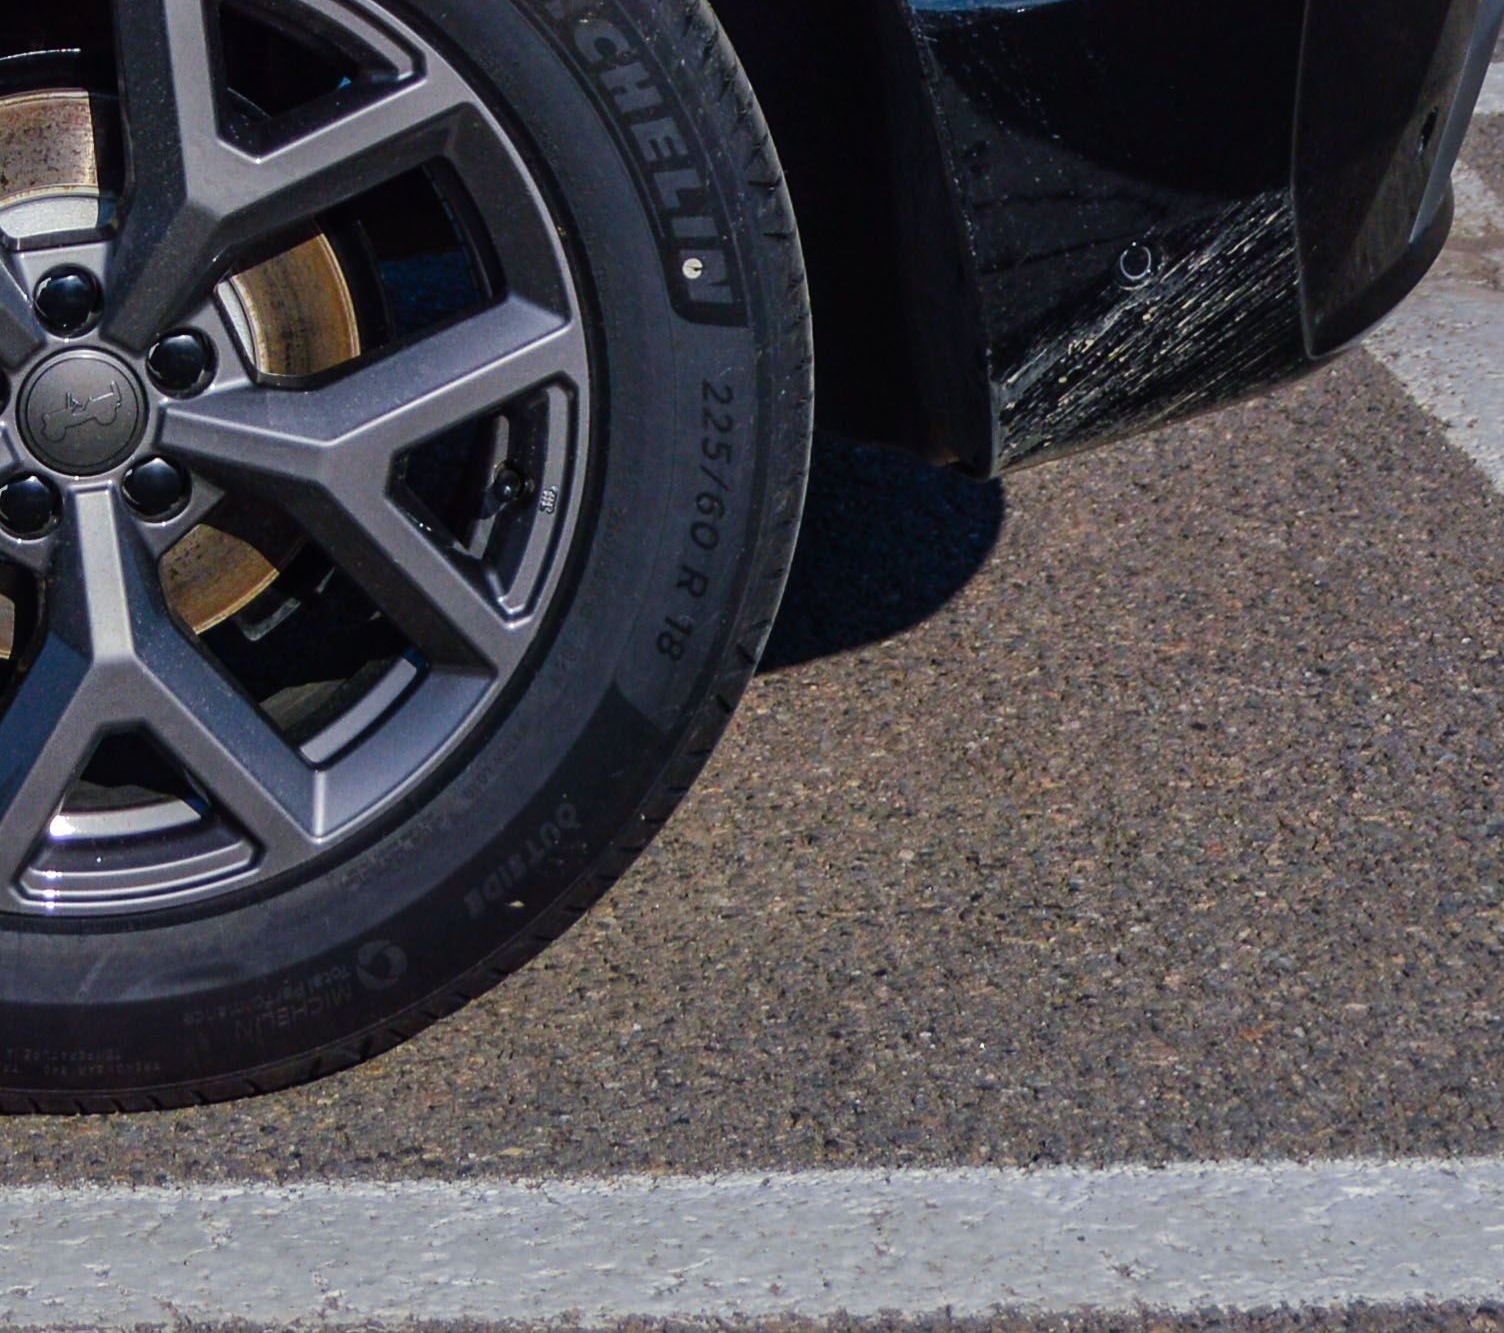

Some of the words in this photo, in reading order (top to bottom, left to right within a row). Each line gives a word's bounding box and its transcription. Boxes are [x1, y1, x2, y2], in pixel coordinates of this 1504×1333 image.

[688, 377, 734, 553] 225/60
[674, 560, 710, 599] R
[655, 611, 691, 667] 18
